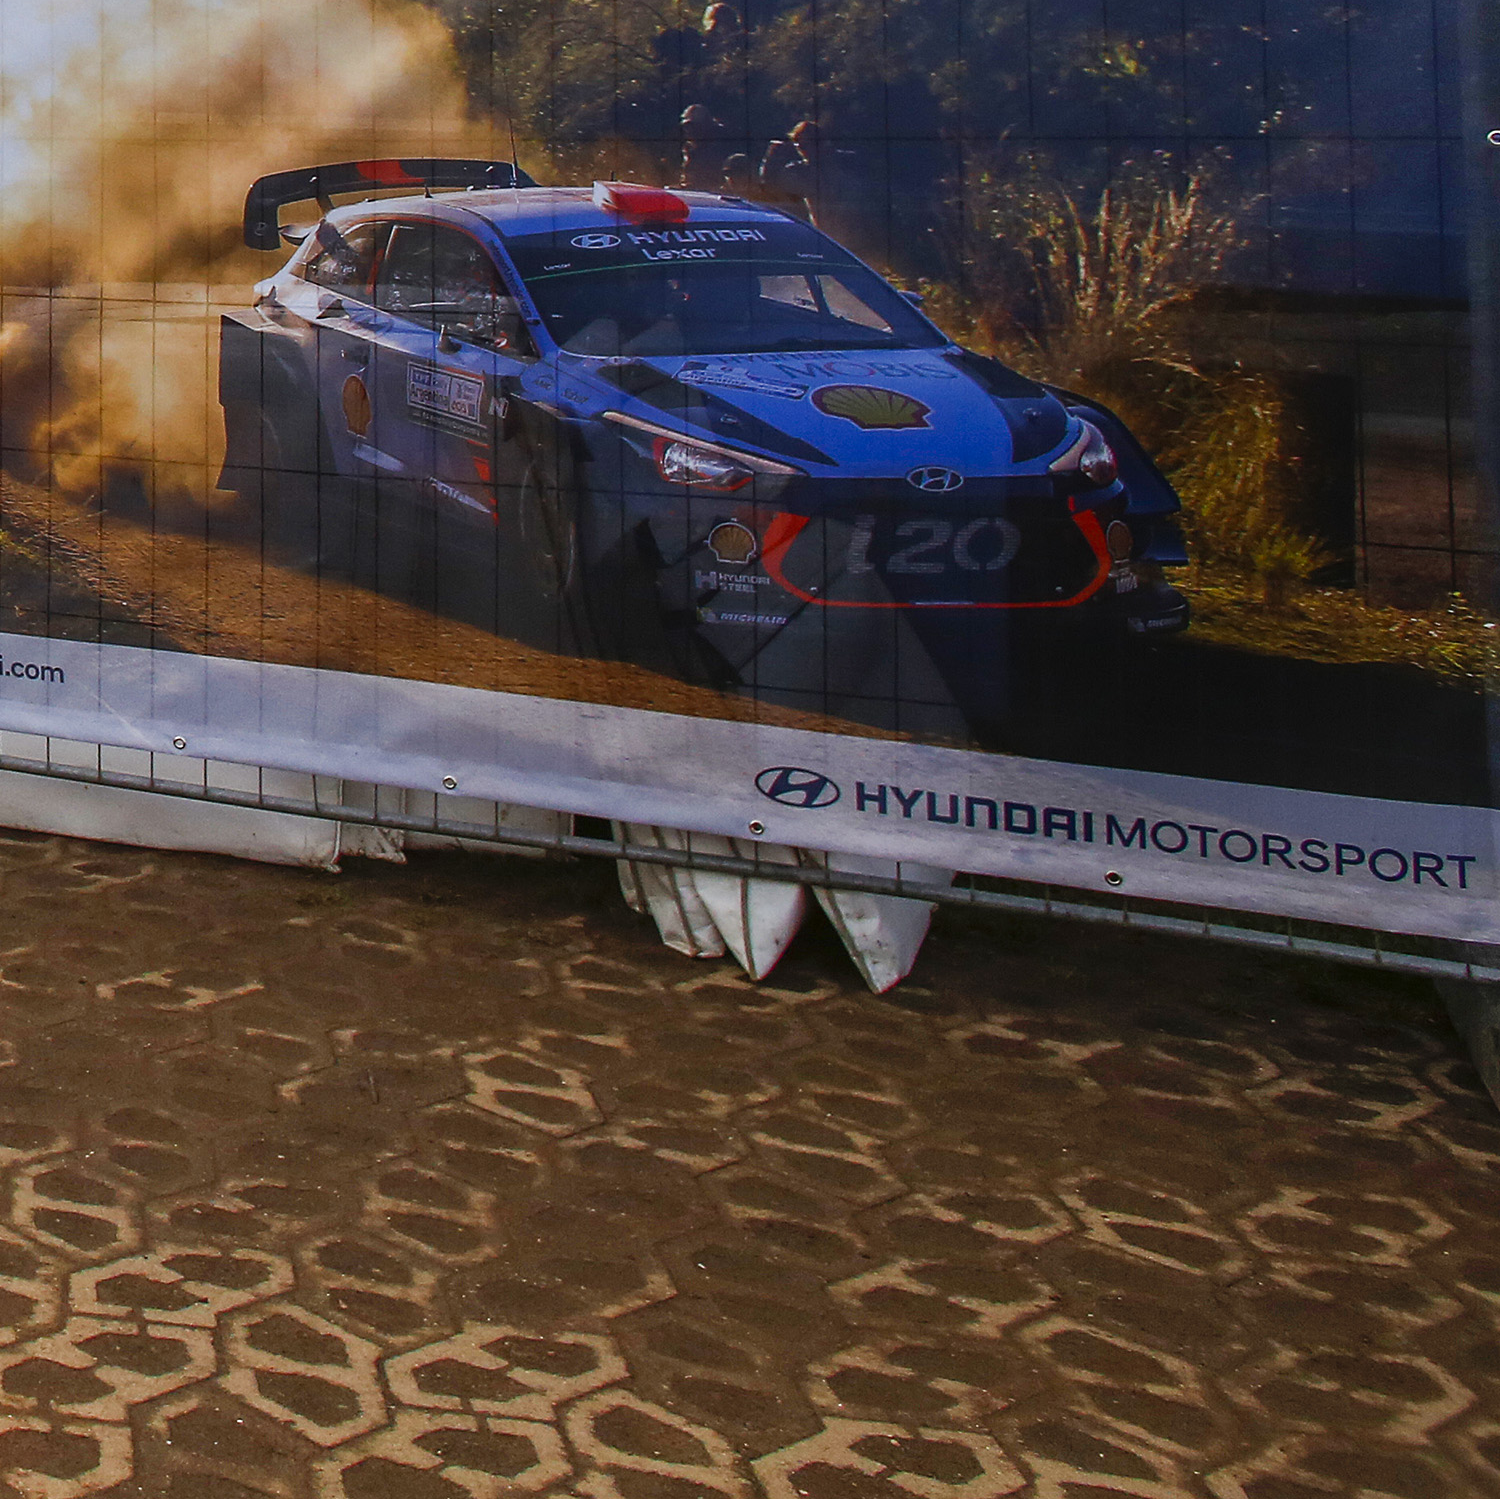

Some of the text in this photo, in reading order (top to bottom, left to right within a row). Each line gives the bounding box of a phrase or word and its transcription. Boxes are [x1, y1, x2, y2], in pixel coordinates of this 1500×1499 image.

[625, 228, 768, 246] HYUNDAI
[640, 247, 717, 261] Lexar
[719, 611, 788, 626] MICHELIN
[854, 780, 1477, 890] HYUNDAI MOTORSPORT
